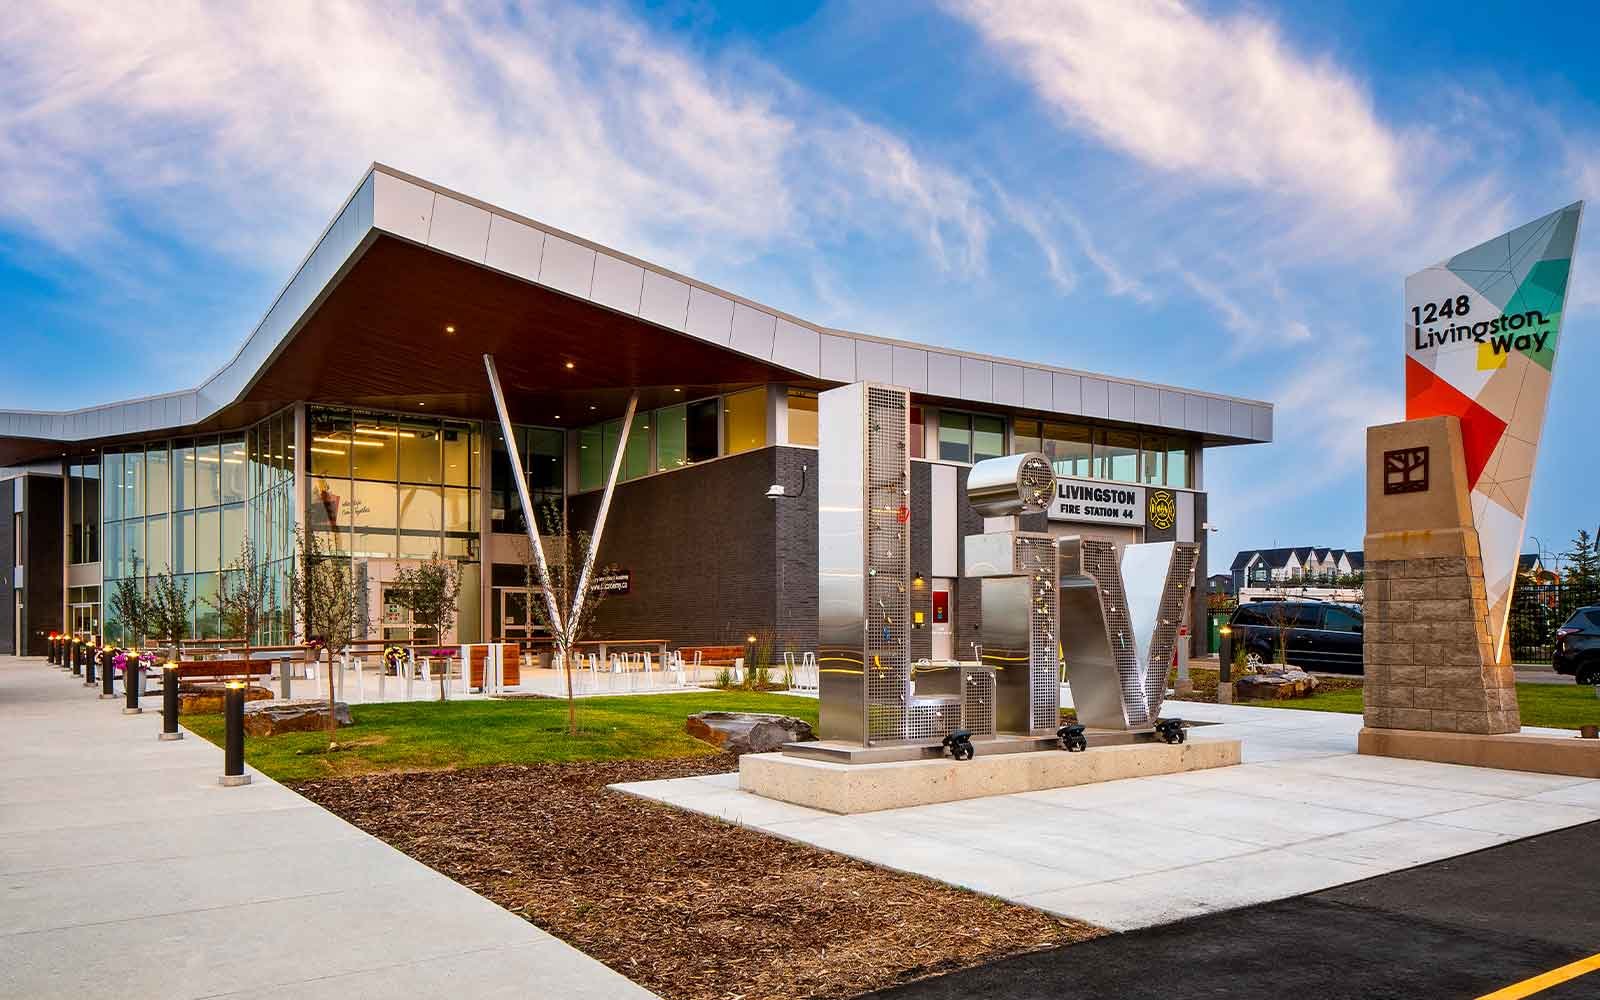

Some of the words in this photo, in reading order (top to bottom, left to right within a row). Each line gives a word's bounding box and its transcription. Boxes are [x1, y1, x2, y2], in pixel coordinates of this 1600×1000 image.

[1411, 295, 1471, 325] 1248
[1415, 310, 1550, 350] Livingston
[1491, 331, 1549, 355] Way
[1058, 484, 1136, 505] LIVINGSTON
[1060, 503, 1081, 514] FIRE
[1084, 505, 1119, 518] STATION
[1122, 509, 1133, 519] 44
